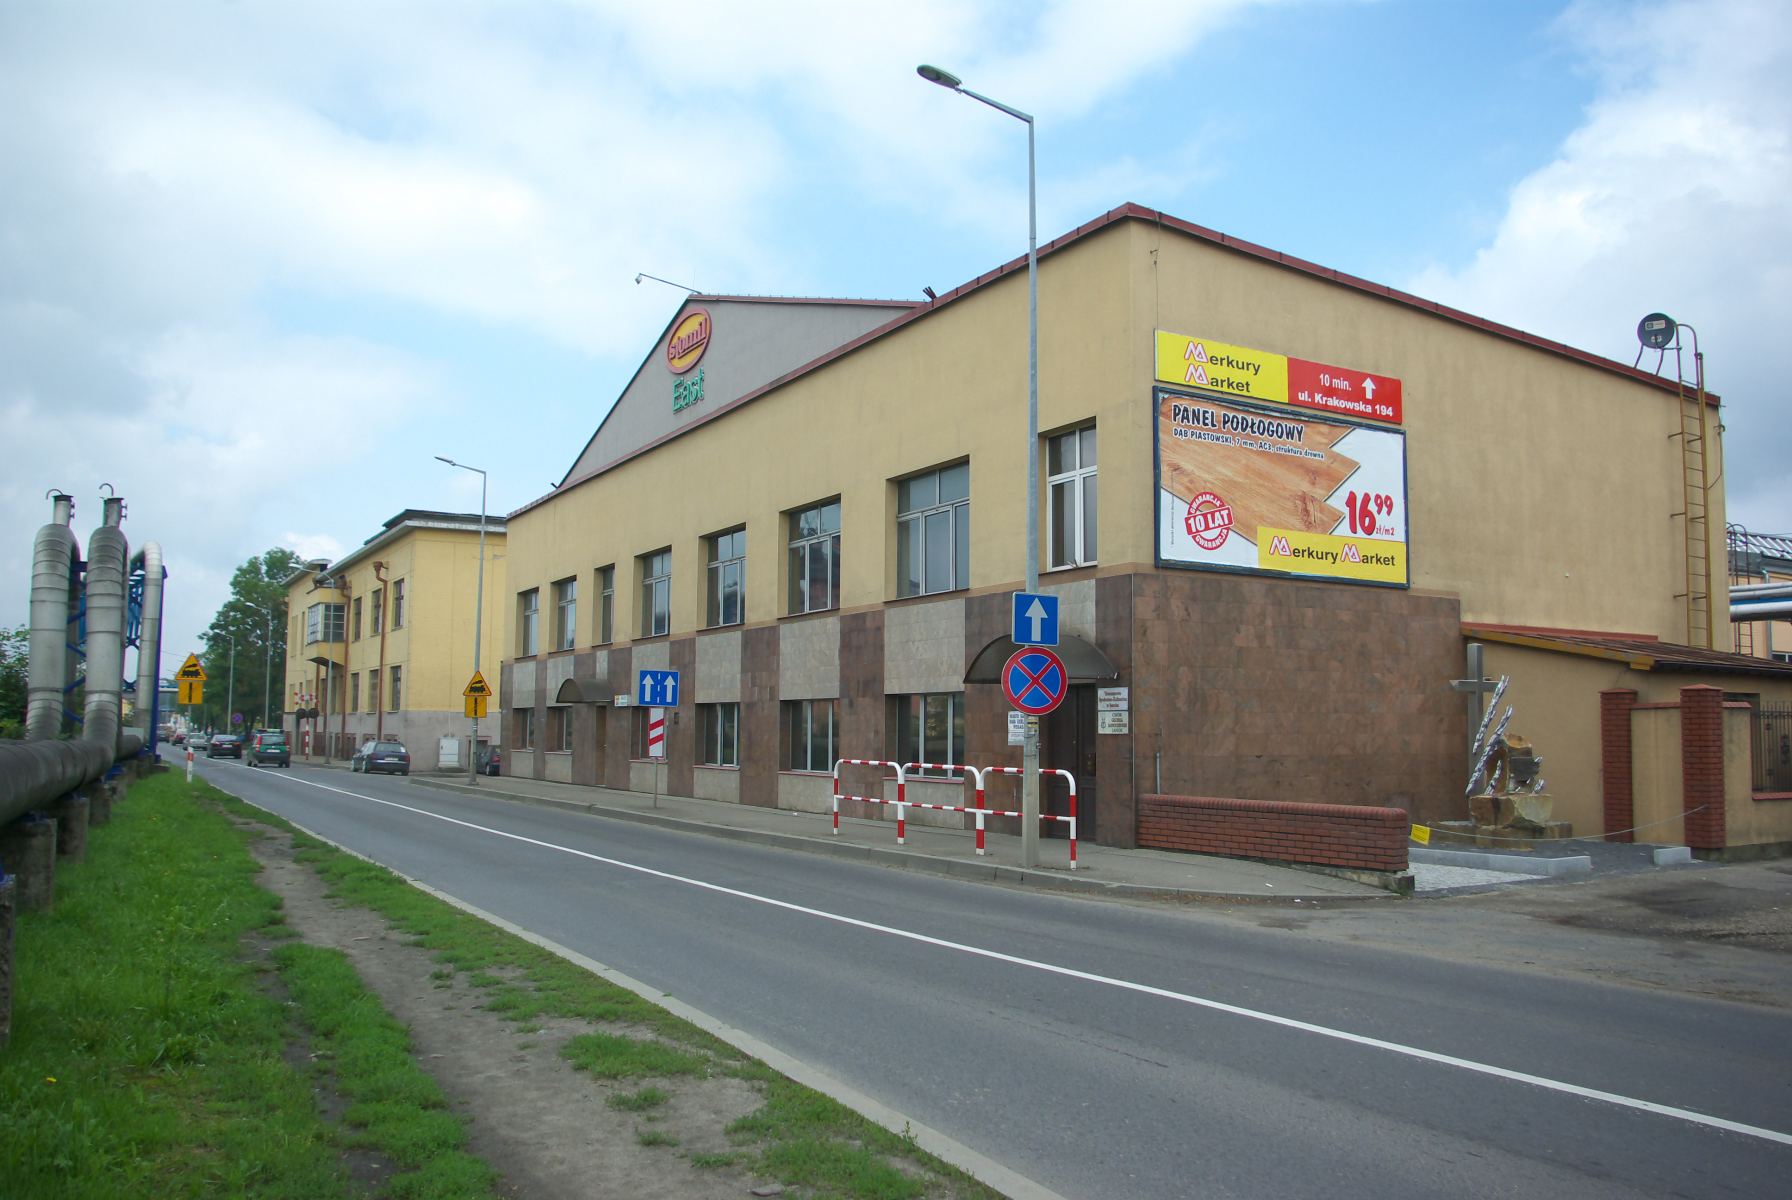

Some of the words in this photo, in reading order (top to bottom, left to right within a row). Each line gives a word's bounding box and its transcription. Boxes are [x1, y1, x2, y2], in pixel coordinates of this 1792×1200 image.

[1184, 341, 1261, 376] Merkury
[672, 367, 705, 415] East
[1184, 363, 1251, 393] Market
[1319, 373, 1330, 387] 10
[1332, 377, 1352, 391] min.
[1298, 391, 1311, 402] ul.
[1314, 393, 1372, 413] Krakowska
[1375, 404, 1393, 416] 194
[1172, 404, 1217, 428] PANEL
[1222, 413, 1304, 442] PODŁOGOWY
[1173, 428, 1188, 439] DĄB
[1236, 438, 1241, 446] 7
[1275, 445, 1303, 456] struktura
[1304, 448, 1324, 459] drewna
[1190, 494, 1221, 514] GWARANCJA
[1188, 515, 1206, 533] 10
[1207, 509, 1229, 528] LAT
[1195, 528, 1228, 549] GWARANCJA
[1269, 536, 1339, 564] Merkury
[1341, 543, 1396, 566] Market
